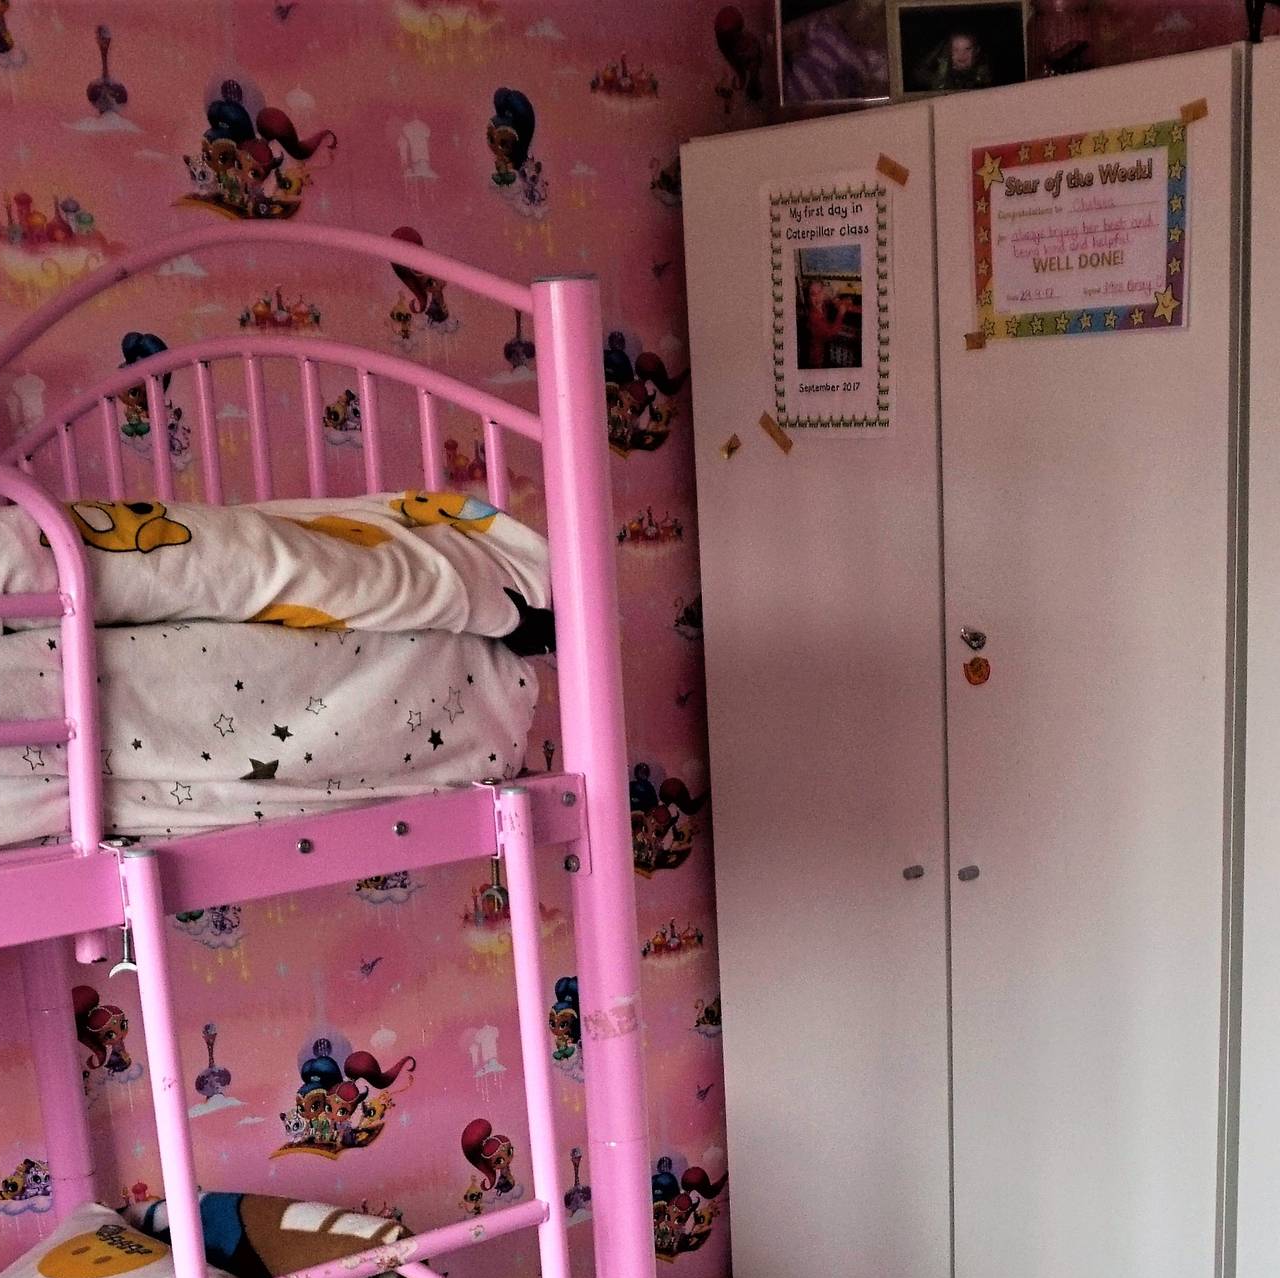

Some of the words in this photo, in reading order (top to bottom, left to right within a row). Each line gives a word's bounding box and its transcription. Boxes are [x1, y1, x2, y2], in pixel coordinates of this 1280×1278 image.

[1005, 176, 1040, 197] Star
[1044, 170, 1064, 198] of
[1066, 168, 1094, 189] the
[1098, 157, 1153, 185] Week!
[789, 207, 802, 222] My
[804, 205, 824, 218] first
[828, 203, 848, 219] day
[852, 202, 863, 214] in
[786, 226, 835, 241] Caterpillar
[840, 224, 869, 236] class
[1032, 254, 1074, 273] WELL
[1078, 250, 1124, 270] DONE!
[799, 382, 840, 393] September
[842, 381, 861, 392] 2017
